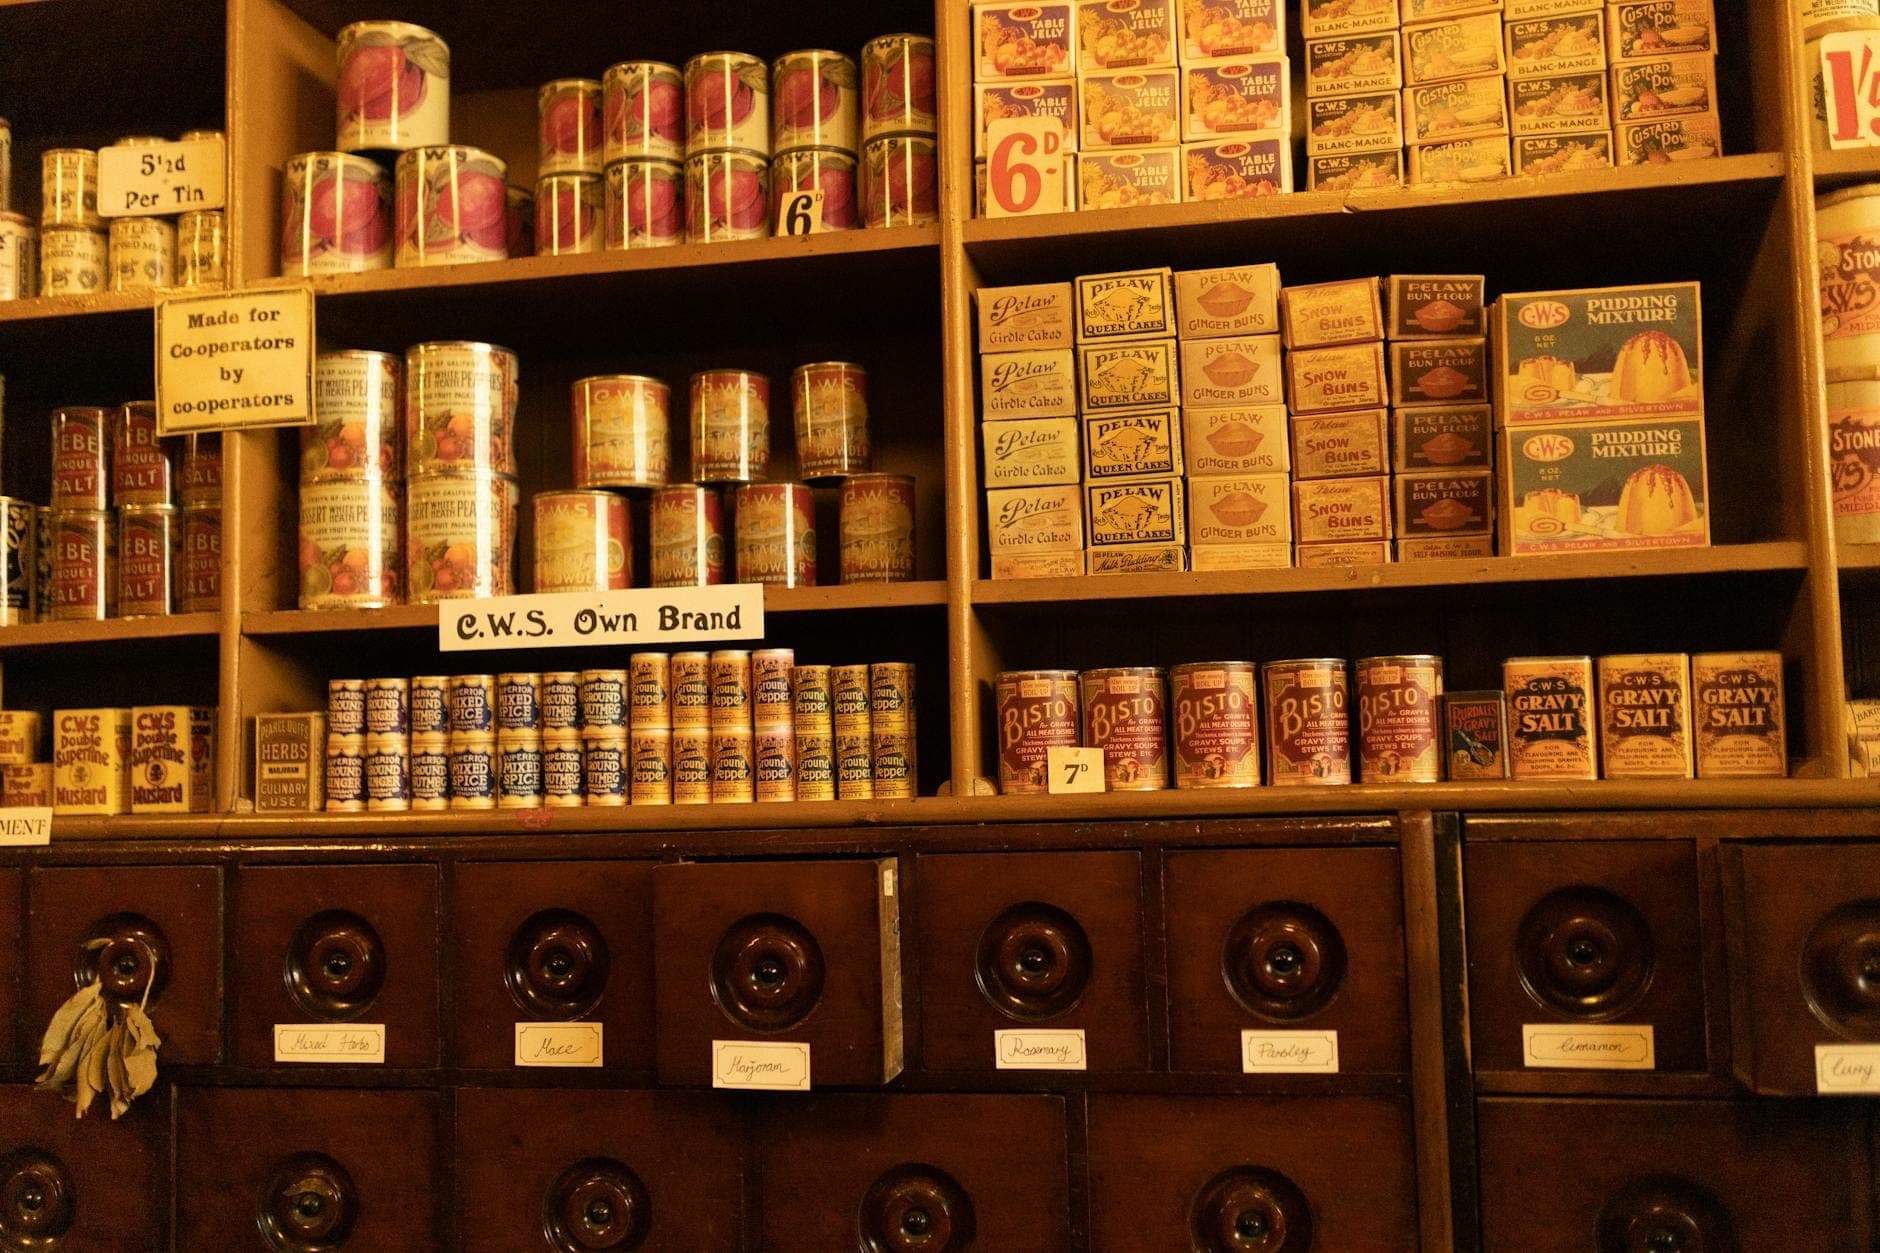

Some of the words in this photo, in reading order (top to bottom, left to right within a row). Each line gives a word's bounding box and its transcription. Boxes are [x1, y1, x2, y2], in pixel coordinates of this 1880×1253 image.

[1129, 8, 1165, 19] TABLE
[1236, 7, 1270, 18] JELLY
[1621, 2, 1672, 28] CUSTARD
[1030, 19, 1065, 29] TABLE
[1129, 17, 1164, 30] JELLY
[1314, 16, 1390, 33] BLANC-MANGE
[1030, 28, 1064, 39] JELLY
[1314, 42, 1349, 54] C.W.S.
[1518, 58, 1598, 75] BLANC-MANGE
[1240, 75, 1276, 86] TABLE
[1620, 63, 1670, 89] CUSTARD
[1240, 84, 1276, 96] JELLY
[1316, 77, 1391, 92] BLANC-MANGE
[1517, 81, 1554, 93] C.W.S.
[1033, 97, 1067, 109] TABLE
[1416, 83, 1466, 109] CUSTARD
[1033, 106, 1067, 117] JELLY
[1315, 101, 1349, 114] C.W.S.
[1519, 118, 1599, 131] BLANC-MANGE
[1627, 121, 1679, 148] CUSTARD
[1317, 137, 1393, 151] BLANC-MANGE
[1524, 139, 1562, 150] C.W.S.
[1239, 154, 1276, 165] TABLE
[1317, 158, 1352, 170] C.W.S.
[1239, 163, 1275, 176] JELLY
[125, 191, 159, 209] Per
[173, 186, 205, 203] Tin
[1200, 272, 1253, 288] PELAW
[1090, 279, 1155, 298] PELAW
[1407, 283, 1474, 293] PELAW
[1407, 293, 1432, 301] BUN
[1436, 291, 1473, 300] FLOUR
[1587, 295, 1677, 312] PUDDING
[990, 295, 1058, 322] Pelaw
[188, 312, 240, 329] Made
[249, 308, 281, 324] for
[1189, 319, 1230, 331] GINGER
[1234, 314, 1265, 328] BUNS
[1587, 308, 1678, 325] MIXTURE
[1086, 324, 1125, 334] QUEEN
[1129, 319, 1163, 330] CAKES
[170, 336, 295, 359] Co-operators
[1205, 343, 1258, 358] PELAW
[1409, 348, 1475, 359] PELAW
[1095, 350, 1160, 370] PELAW
[1408, 359, 1434, 368] BUN
[1438, 358, 1475, 366] FLOUR
[220, 366, 243, 384] by
[992, 361, 1057, 388] Pelaw
[1303, 370, 1348, 388] SNOW
[1193, 389, 1235, 400] GINGER
[1239, 385, 1270, 398] BUNS
[1323, 382, 1370, 396] BUNS
[173, 391, 294, 414] co-operators
[1090, 395, 1130, 405] QUEEN
[1132, 392, 1168, 401] CAKES
[1209, 412, 1263, 428] PELAW
[1098, 419, 1162, 439] PELAW
[995, 429, 1060, 456] Pelaw
[1591, 429, 1682, 445] PUDDING
[1305, 438, 1350, 455] SNOW
[1592, 442, 1682, 458] MIXTURE
[1197, 458, 1239, 469] GINGER
[1243, 455, 1274, 467] BUNS
[1325, 450, 1372, 463] BUNS
[1094, 464, 1132, 474] QUEEN
[1135, 461, 1170, 471] CAKES
[1213, 482, 1266, 497] PELAW
[1413, 480, 1480, 491] PELAW
[1100, 487, 1164, 506] PELAW
[1412, 491, 1438, 500] BUN
[1442, 490, 1480, 499] FLOUR
[1000, 497, 1065, 524] Pelaw
[1309, 504, 1353, 520] SNOW
[1328, 516, 1374, 528] BUNS
[1095, 532, 1134, 542] QUEEN
[1137, 529, 1171, 539] CAKES
[1201, 528, 1242, 539] GINGER
[1246, 525, 1277, 536] BUNS
[457, 610, 554, 640] C.W.S.
[574, 608, 638, 635] Own
[658, 605, 741, 630] Brand
[758, 680, 788, 691] Ground
[584, 692, 620, 702] GROUND
[756, 691, 790, 703] Pepper
[1515, 694, 1583, 710] GRAVY
[1608, 689, 1680, 705] GRAVY
[1703, 688, 1773, 704] GRAVY
[584, 704, 620, 714] NUTMEG
[1280, 691, 1343, 741] BISTO
[1360, 688, 1418, 736] BISTO
[1712, 707, 1766, 726] SALT
[1004, 700, 1066, 749] BISTO
[1092, 697, 1154, 745] BISTO
[1178, 692, 1241, 742] BISTO
[1522, 713, 1575, 732] SALT
[1616, 709, 1670, 727] SALT
[61, 735, 102, 749] Double
[137, 731, 177, 747] Double
[56, 748, 109, 768] Superfine
[132, 747, 185, 766] Superfine
[262, 743, 308, 760] HERBS
[452, 763, 487, 774] MIXED
[504, 762, 540, 772] MIXED
[716, 758, 746, 769] Ground
[800, 760, 829, 769] Ground
[452, 774, 487, 787] SPICE
[504, 774, 540, 785] SPICE
[715, 769, 748, 780] Pepper
[799, 770, 831, 781] Pepper
[56, 786, 107, 805] Mustard
[133, 784, 182, 804] Mustard
[261, 783, 307, 794] CULINARY
[270, 797, 296, 807] USE
[534, 1038, 583, 1057] Mace
[1008, 1038, 1072, 1061] Rosemary
[1258, 1042, 1315, 1060] Parsley
[726, 1056, 790, 1081] Marjoram
